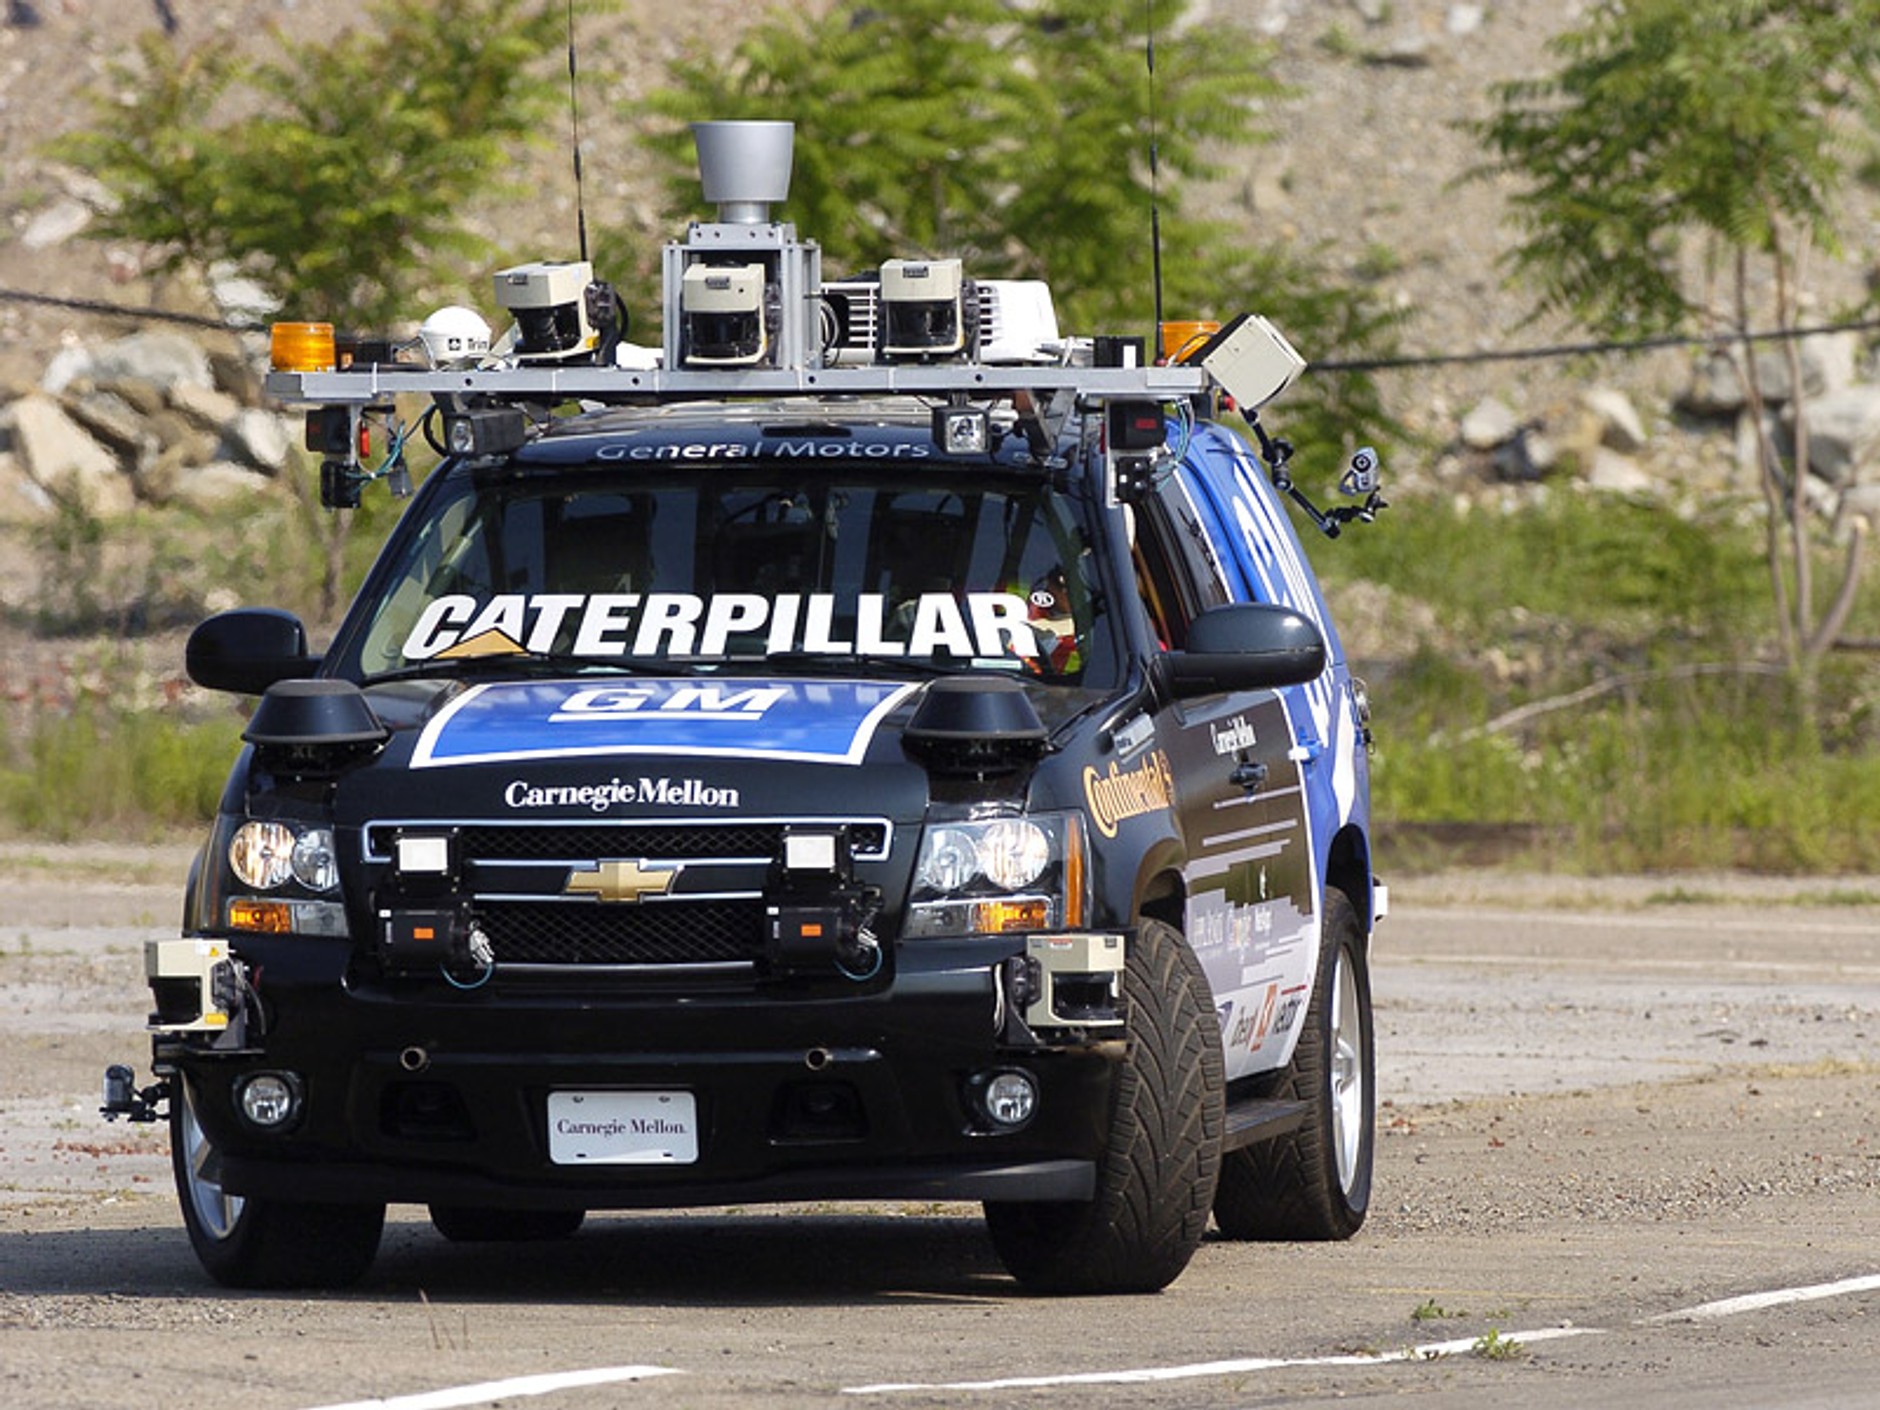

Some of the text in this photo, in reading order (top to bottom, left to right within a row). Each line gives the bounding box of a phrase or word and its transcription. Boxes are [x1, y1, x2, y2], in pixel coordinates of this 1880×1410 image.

[596, 441, 930, 460] General Motors
[402, 593, 1041, 660] CATERPILLAR
[560, 688, 788, 711] GM
[505, 778, 739, 812] Carnegie Mellon
[557, 1119, 627, 1139] Carnegie
